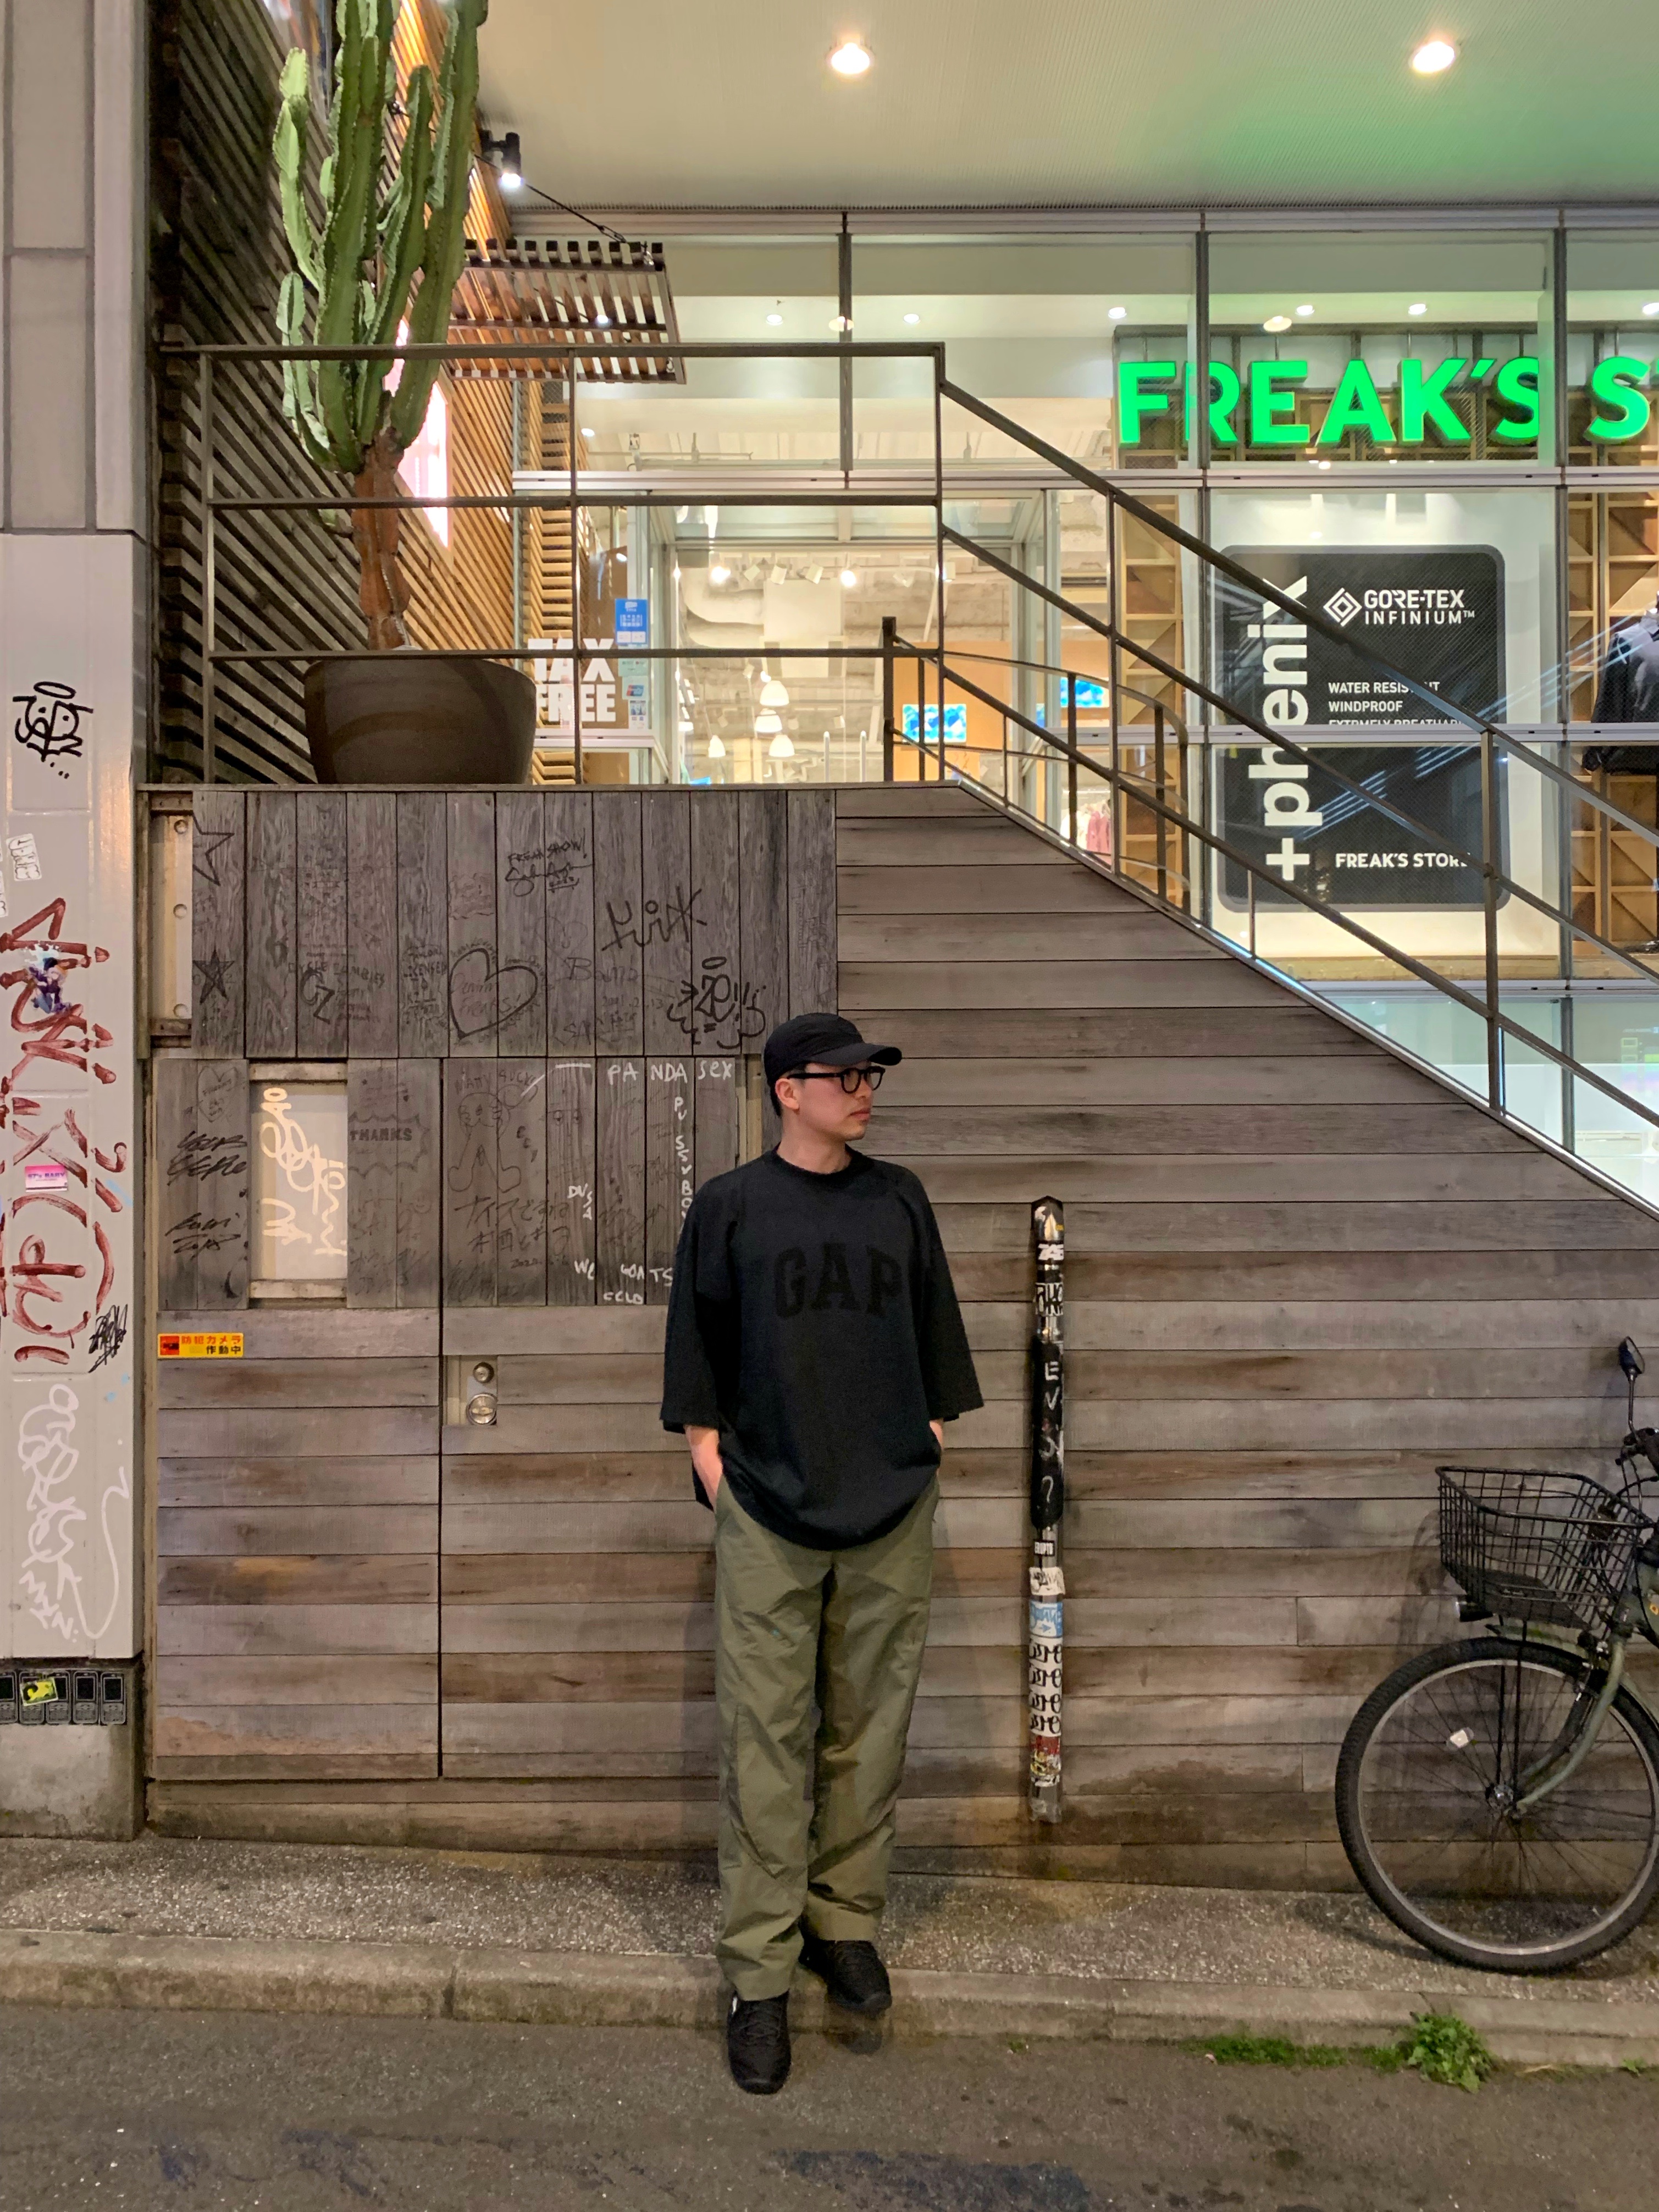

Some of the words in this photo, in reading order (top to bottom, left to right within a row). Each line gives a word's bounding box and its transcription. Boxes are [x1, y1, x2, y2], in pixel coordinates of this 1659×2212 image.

[1119, 357, 1539, 442] FREAK'S
[1590, 355, 1659, 441] S
[1364, 589, 1465, 609] GORE-TEX
[528, 638, 616, 682] TAX
[1328, 682, 1370, 694] WATER
[1373, 681, 1440, 694] RESIST
[535, 684, 616, 722] FREE
[1328, 700, 1403, 712] WINDPROOF
[1335, 853, 1408, 868] FREAK'S
[350, 1127, 412, 1142] THANKS
[774, 1241, 903, 1318] GAP
[206, 1345, 241, 1354] 作動中
